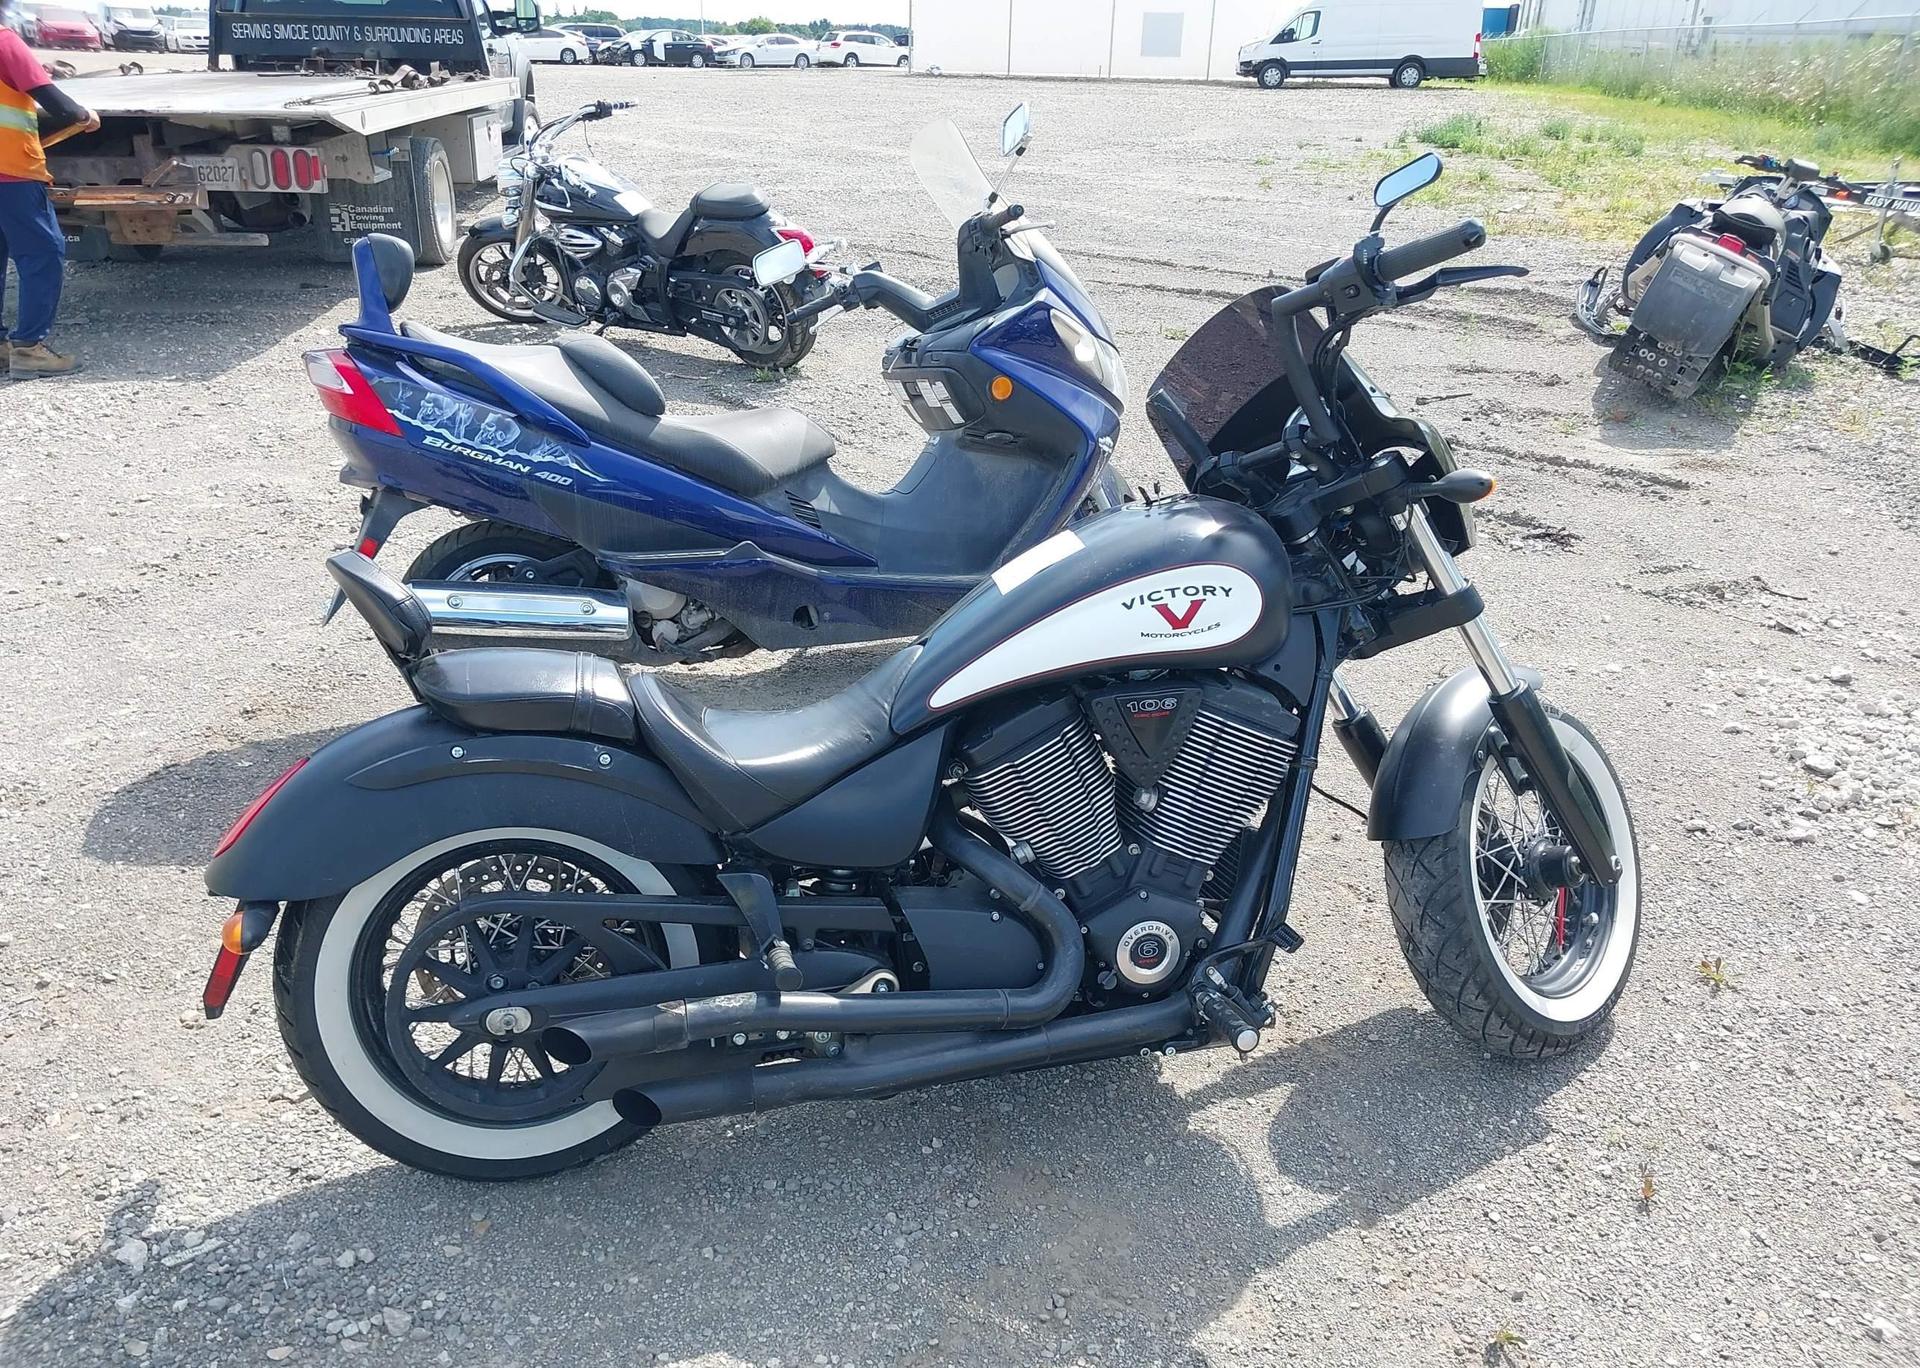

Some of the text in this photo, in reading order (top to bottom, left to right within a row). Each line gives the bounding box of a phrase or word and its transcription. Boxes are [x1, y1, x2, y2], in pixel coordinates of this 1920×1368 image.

[231, 23, 464, 44] SERVING SIMCOE COUNTY & SURROUNDING AREAS
[198, 165, 235, 182] 62027
[348, 204, 394, 213] Canadian
[1863, 195, 1920, 212] EASY HAU
[349, 213, 385, 222] Towing
[350, 220, 402, 231] Equipment
[421, 434, 573, 486] BURGMAN 400
[1121, 585, 1233, 611] VICTORY
[1151, 598, 1207, 630] V
[1140, 622, 1221, 638] MOTORCYCLES
[1126, 697, 1178, 713] 106
[1123, 925, 1175, 947] OVERDRIVE
[1137, 940, 1159, 958] 6
